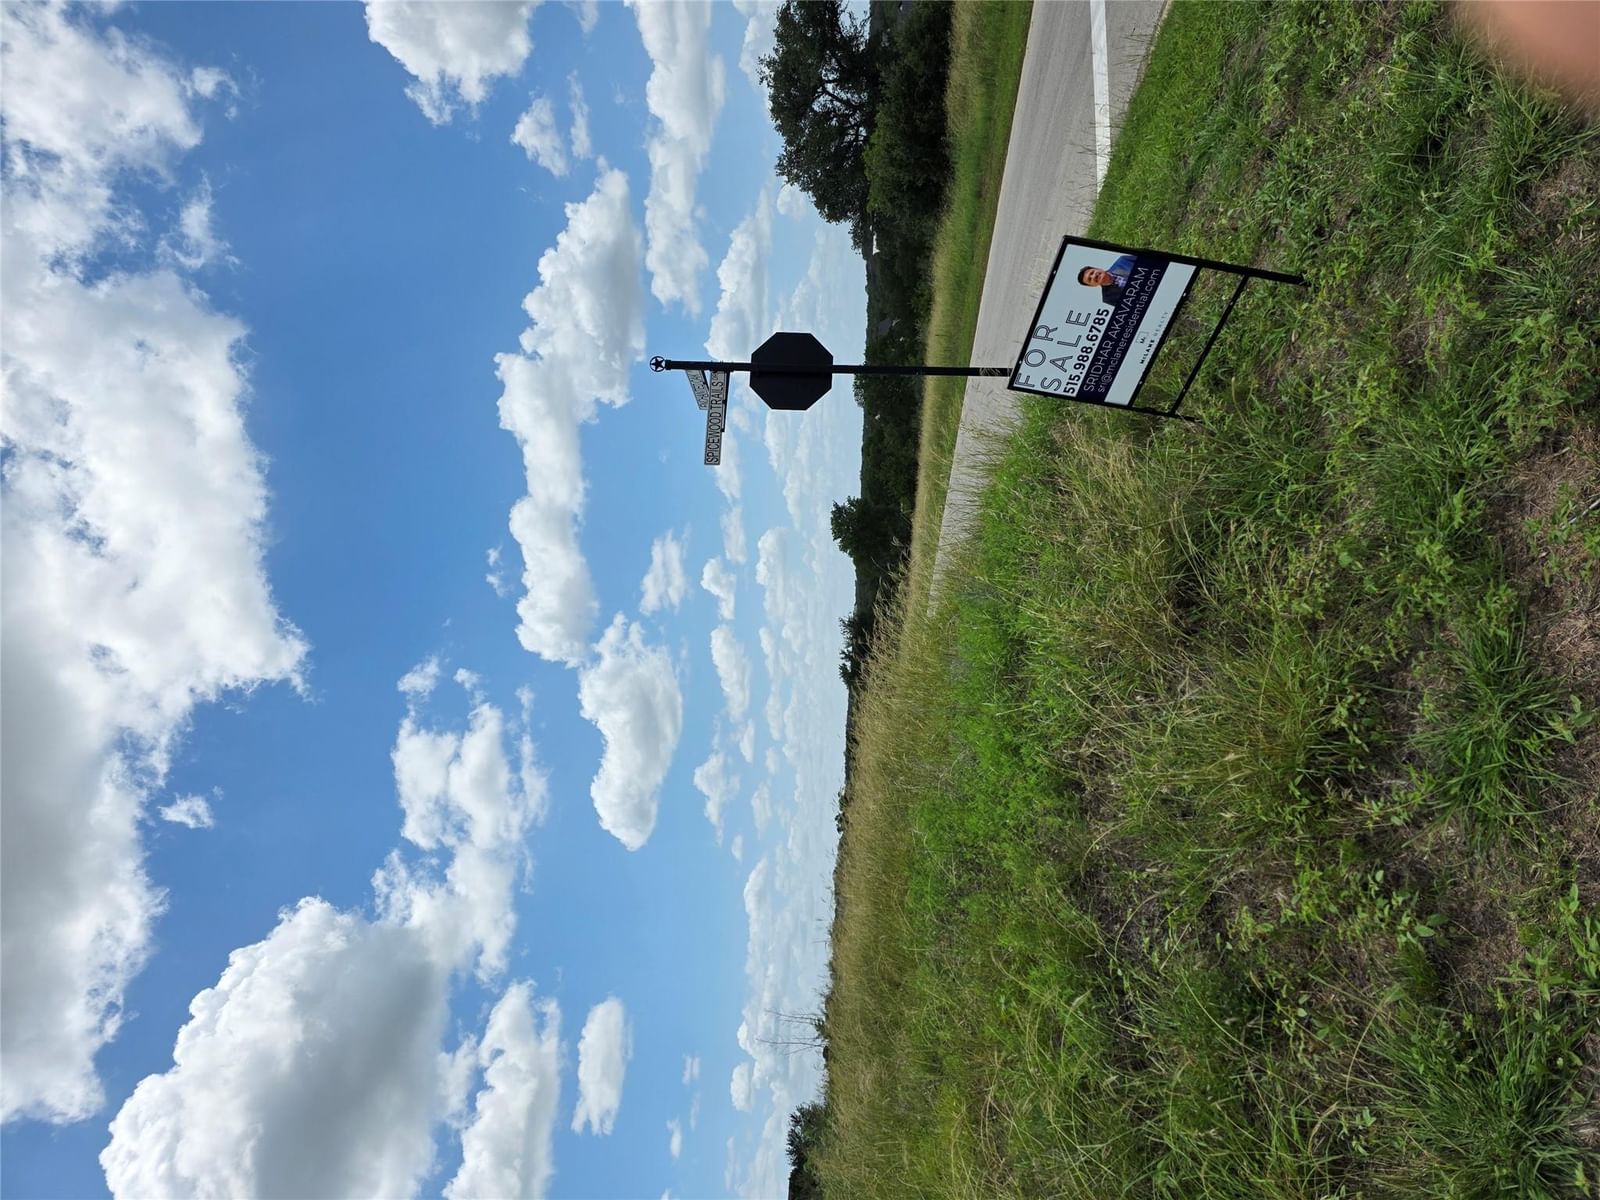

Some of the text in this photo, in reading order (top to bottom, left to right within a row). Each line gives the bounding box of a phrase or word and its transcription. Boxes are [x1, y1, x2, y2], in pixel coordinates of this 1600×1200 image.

[1015, 324, 1058, 388] FOR
[1040, 310, 1091, 392] SALE
[1063, 308, 1109, 394] 515.988.6785
[1083, 267, 1149, 392] SRIDHAR AKAVARAM
[1098, 268, 1161, 393] sri@mclaneresidential.com
[711, 381, 724, 410] TRAILS
[706, 411, 722, 463] SPICEWOOD
